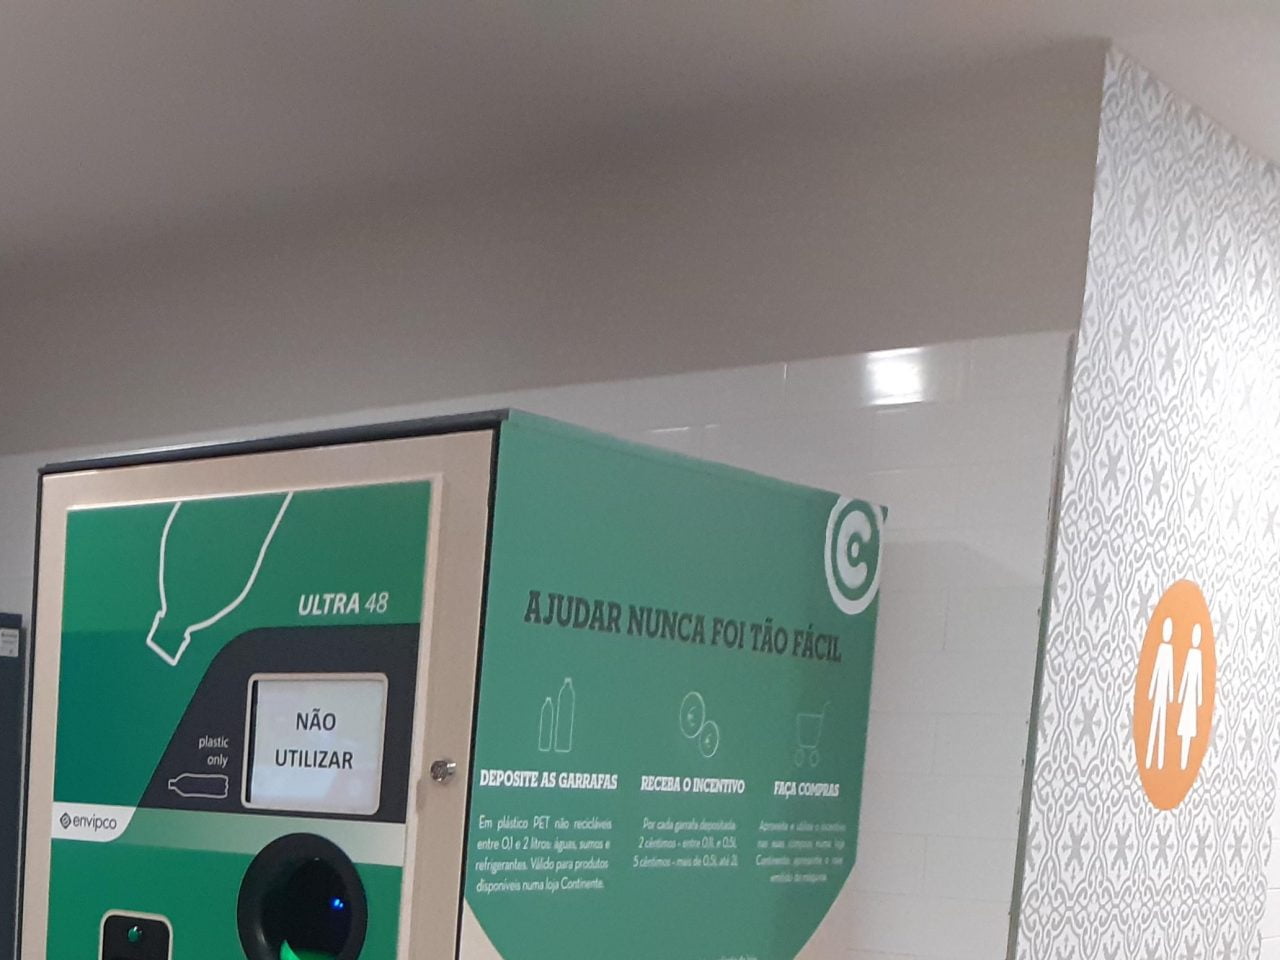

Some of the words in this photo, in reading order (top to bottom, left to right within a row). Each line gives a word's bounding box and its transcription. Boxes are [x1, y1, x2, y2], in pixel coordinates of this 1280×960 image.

[298, 592, 360, 616] ULTRA
[364, 591, 389, 614] 48
[523, 589, 622, 634] AJUDAR
[626, 604, 705, 644] NUNCA
[710, 616, 746, 649] FOI
[749, 616, 788, 655] TÃO
[792, 623, 842, 663] FÁCIL
[296, 708, 337, 731] NÃO
[198, 736, 229, 749] plastic
[207, 754, 229, 768] only
[275, 748, 353, 770] UTILIZAR
[479, 769, 539, 788] DEPOSITE
[540, 771, 557, 788] AS
[558, 772, 618, 790] GARRAFAS
[640, 775, 680, 792] RECEBA
[683, 776, 692, 792] O
[693, 777, 745, 794] INCENTIVO
[773, 781, 797, 799] FAÇA
[797, 782, 840, 797] COMPRAS
[72, 813, 118, 832] envipco
[478, 814, 493, 830] Em
[496, 815, 529, 832] plástico
[533, 815, 551, 830] PET
[554, 817, 569, 830] não
[476, 837, 500, 850] entre
[515, 840, 521, 850] e
[522, 836, 529, 850] 2
[638, 836, 645, 849] 2
[555, 859, 573, 873] para
[574, 858, 609, 872] produtos
[632, 854, 639, 868] 5
[522, 880, 544, 891] numa
[545, 877, 560, 893] loja
